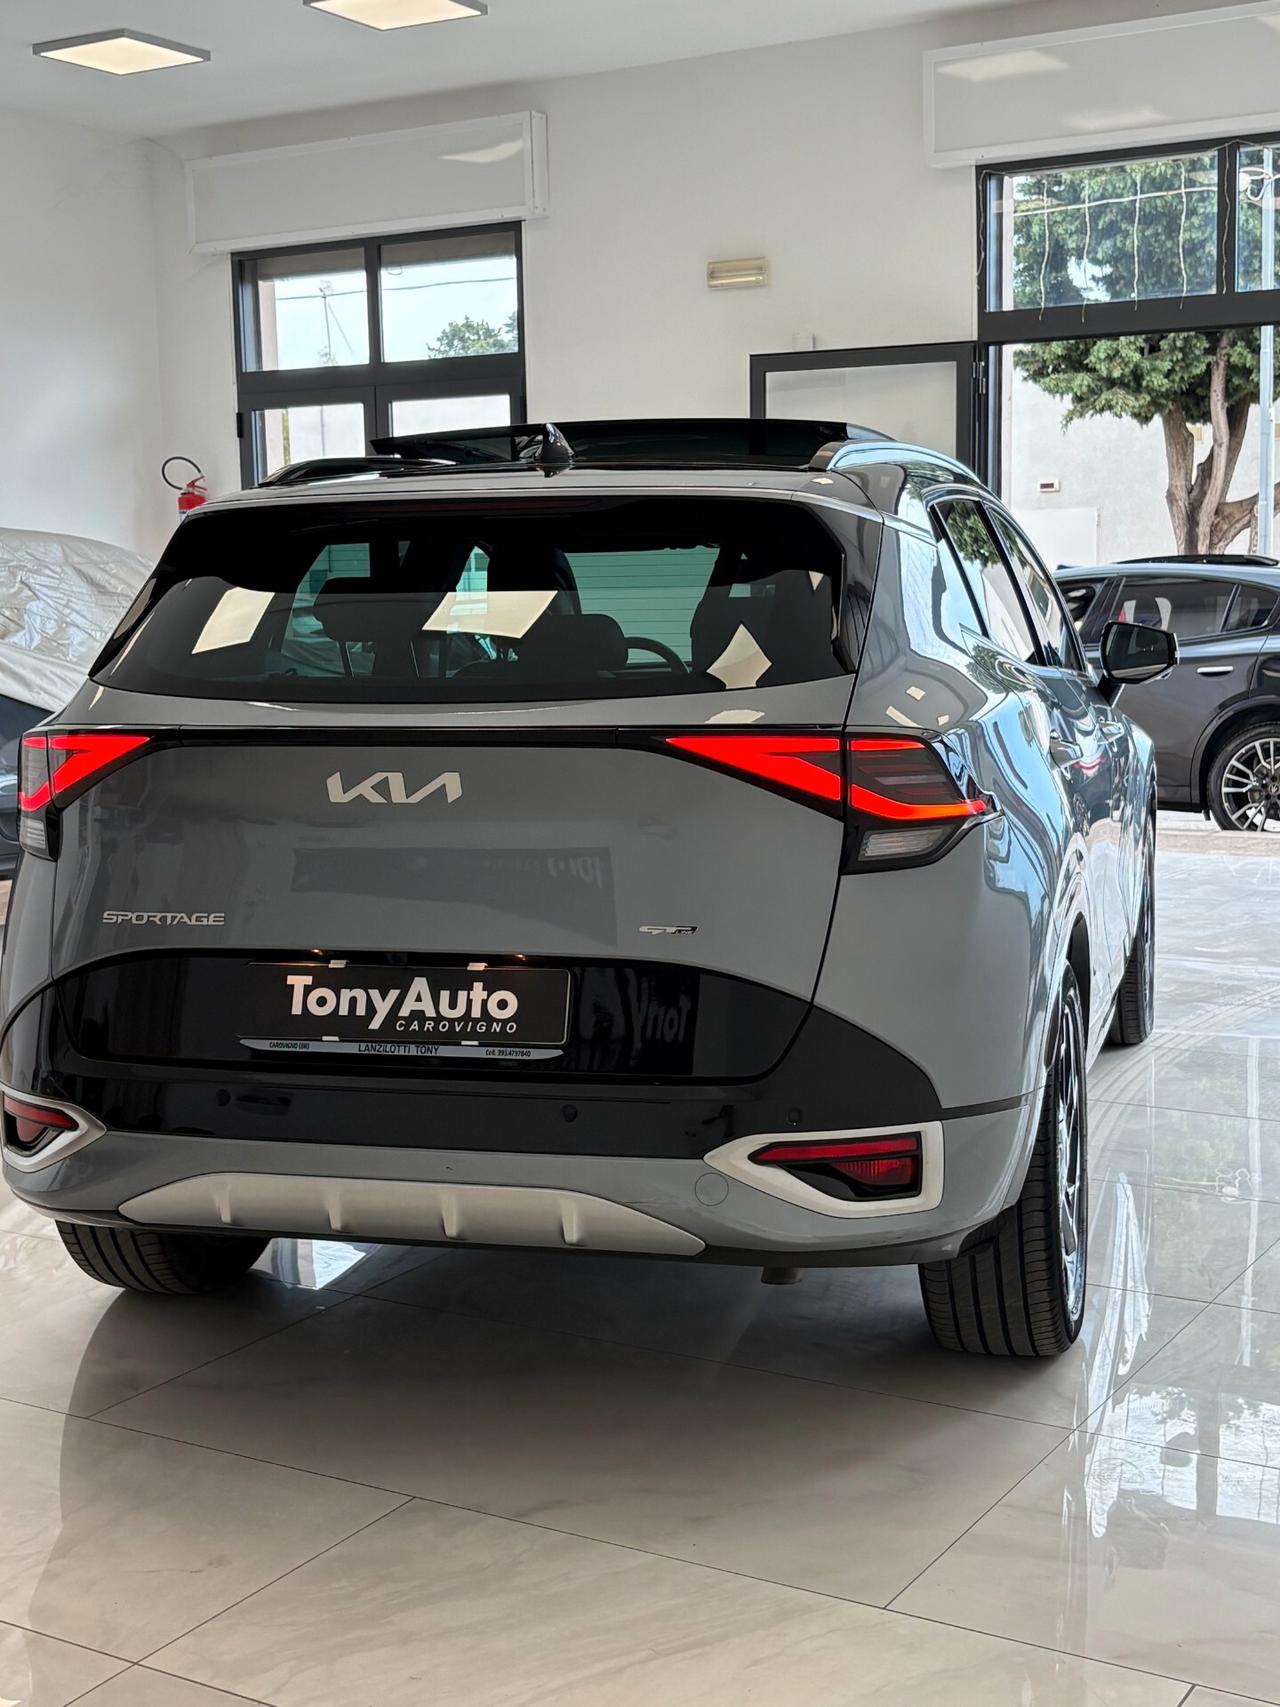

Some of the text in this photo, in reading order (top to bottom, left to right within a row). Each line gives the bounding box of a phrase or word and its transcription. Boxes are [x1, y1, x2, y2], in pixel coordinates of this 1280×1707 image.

[326, 771, 463, 803] KIA
[103, 910, 225, 926] SPORTAGE
[395, 1020, 518, 1033] CAROVIGNO
[358, 1043, 440, 1055] LANZILOTTI TONY
